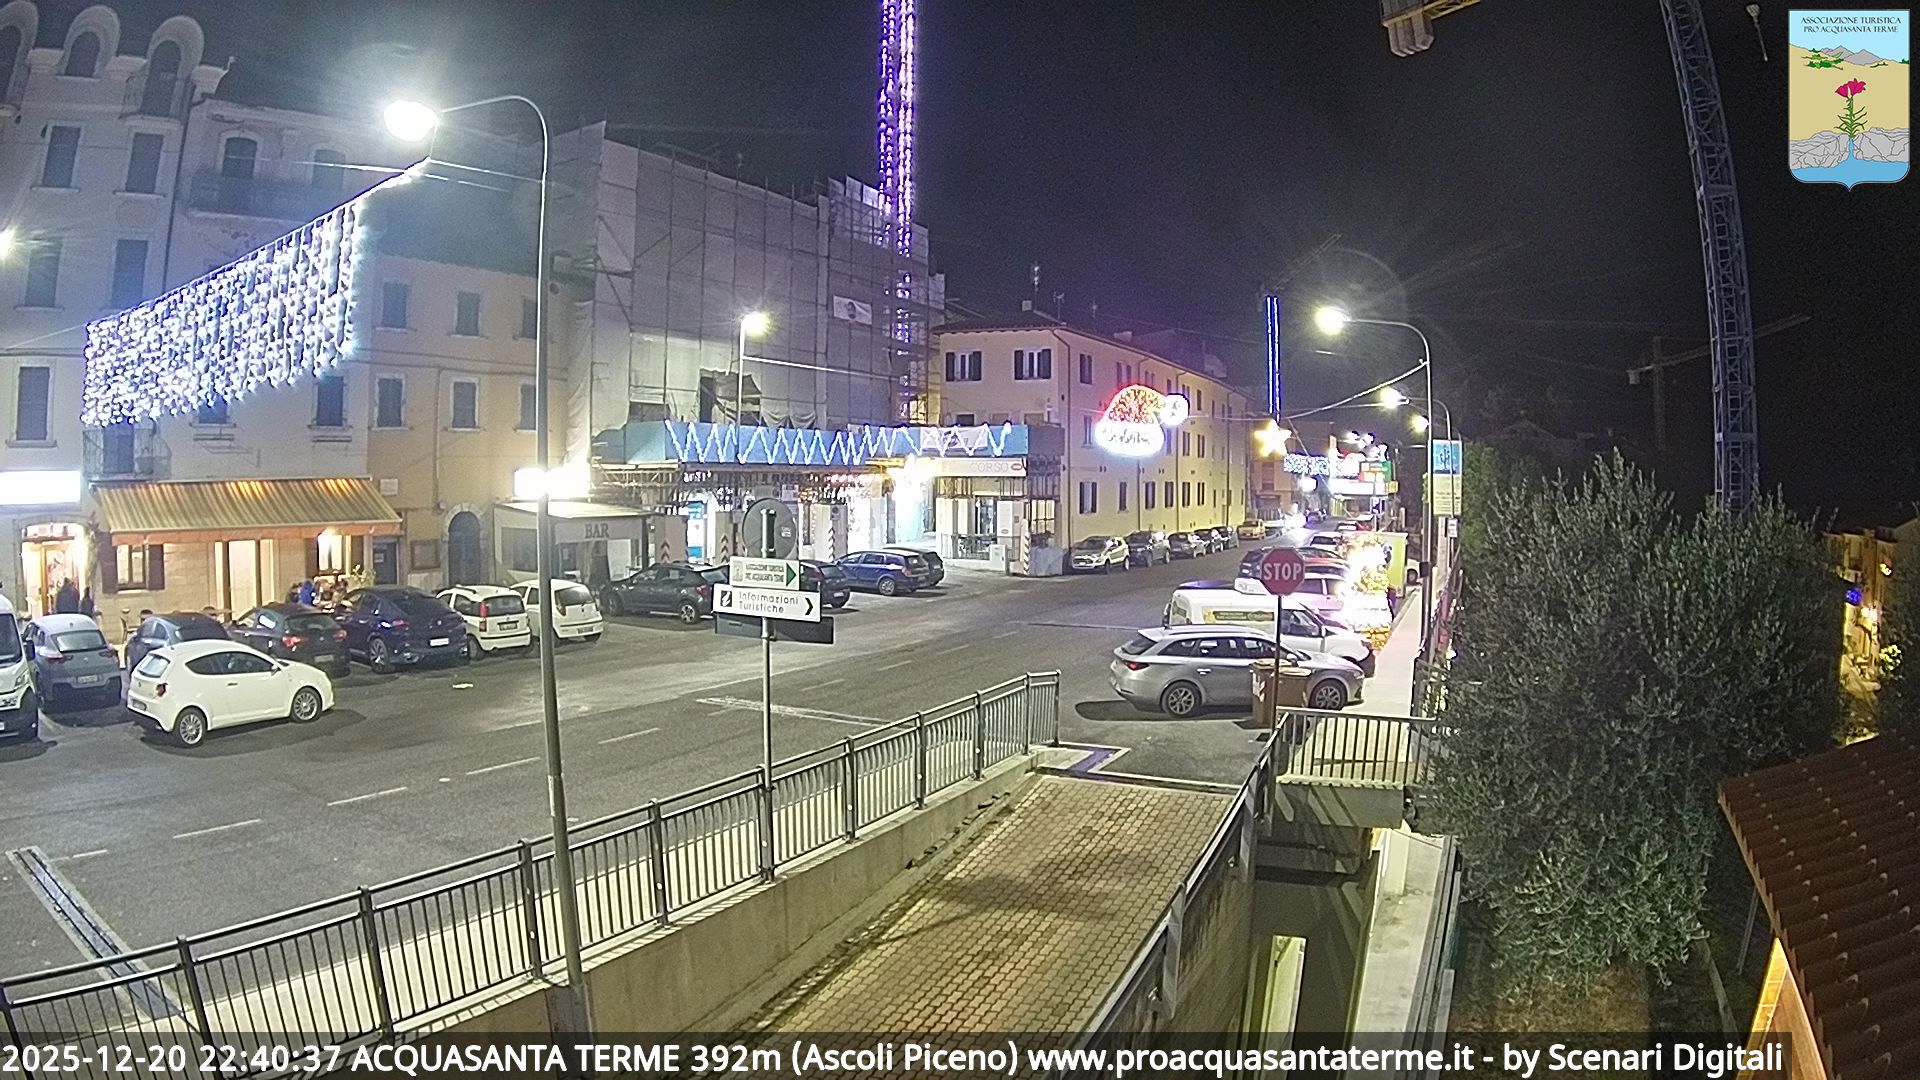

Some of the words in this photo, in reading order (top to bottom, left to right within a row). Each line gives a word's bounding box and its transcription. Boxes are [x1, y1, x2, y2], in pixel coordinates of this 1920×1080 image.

[585, 522, 610, 539] BAR
[1263, 562, 1301, 581] STOP
[739, 591, 799, 605] Informazioni
[739, 601, 785, 614] Turistiche
